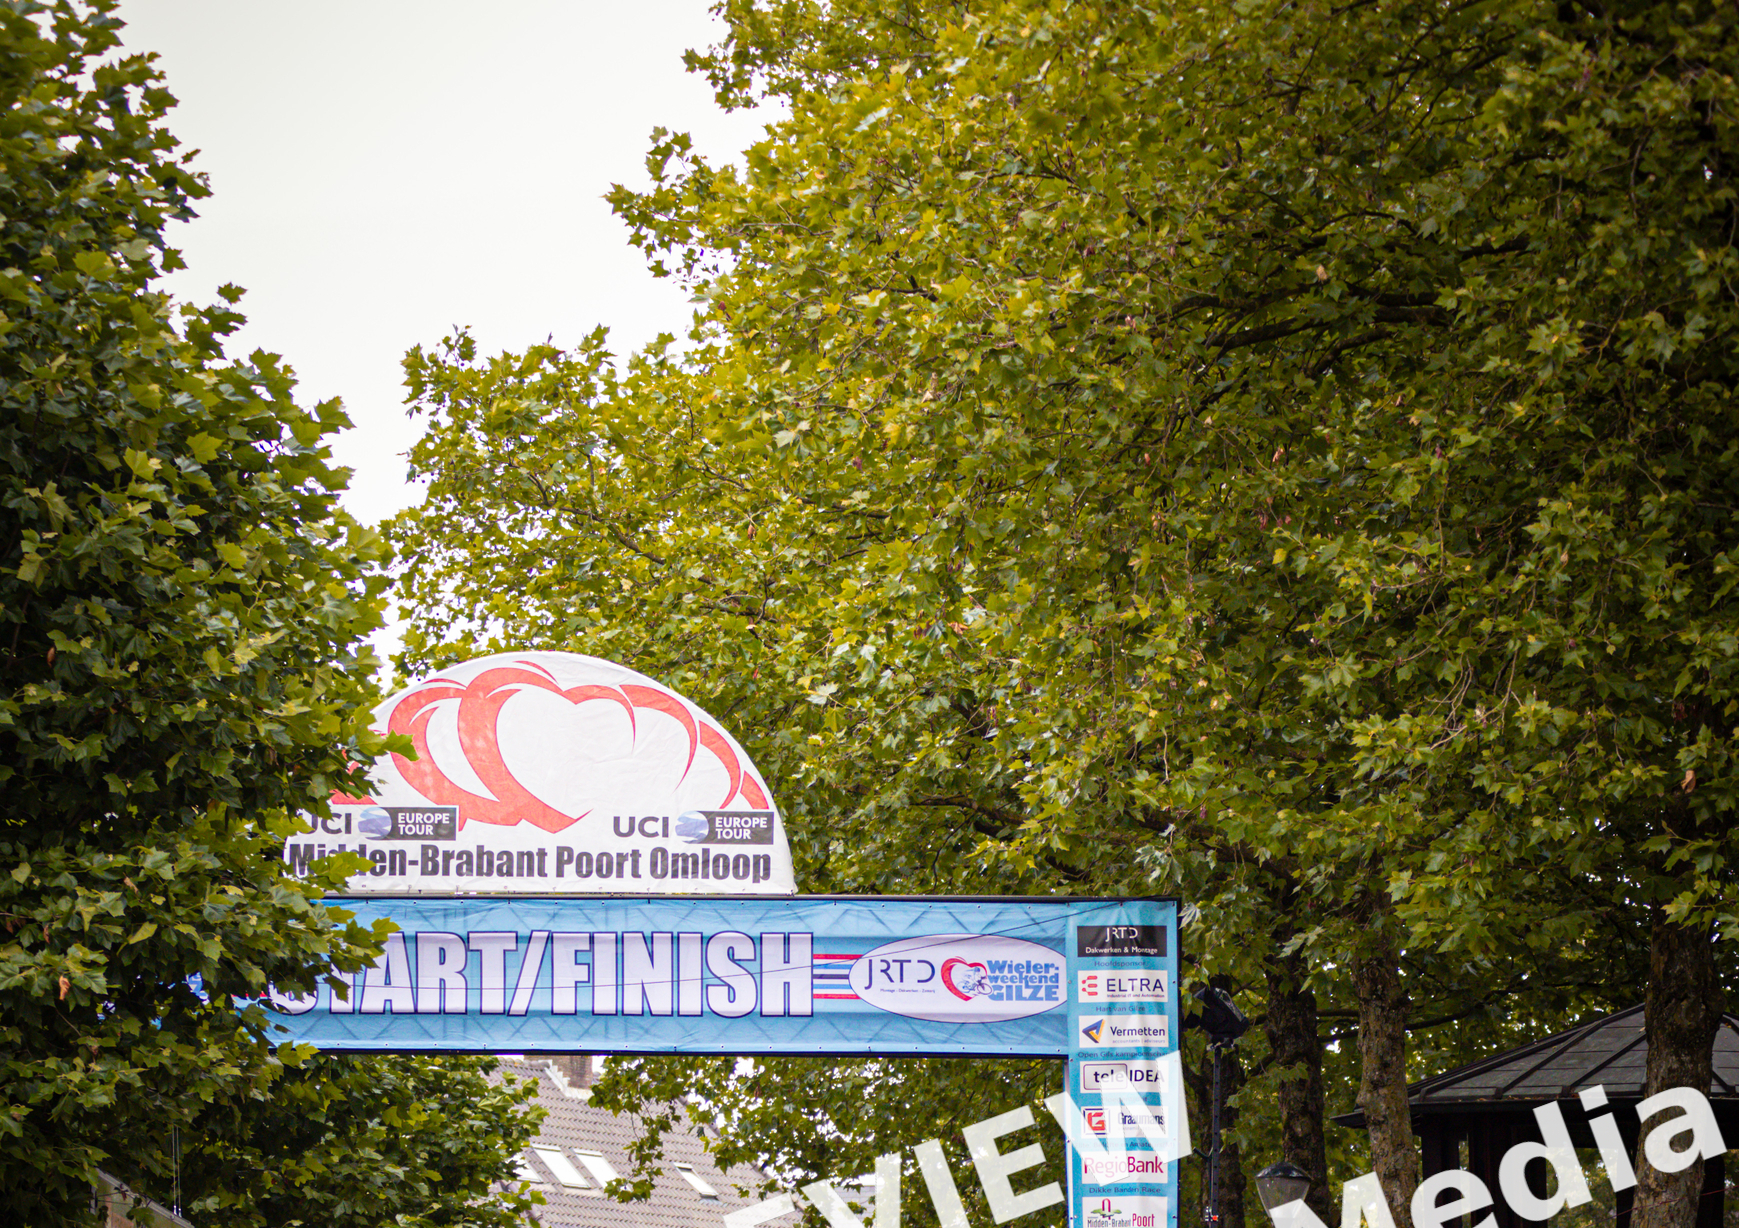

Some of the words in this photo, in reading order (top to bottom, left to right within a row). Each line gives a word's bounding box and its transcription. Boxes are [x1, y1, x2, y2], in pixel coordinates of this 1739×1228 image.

[397, 812, 450, 824] EUROPE
[715, 816, 768, 829] EUROPE
[397, 824, 435, 836] TOUR
[612, 815, 670, 839] UCI
[715, 828, 753, 840] TOUR
[555, 845, 642, 879] Poort
[649, 846, 772, 884] Omloop
[1085, 946, 1122, 955] Dakwerken
[1124, 946, 1130, 954] &
[1131, 946, 1158, 956] Montage
[1094, 960, 1146, 968] Hoofdsponsor
[987, 972, 1060, 988] weekend
[1106, 977, 1164, 993] ELTRA
[988, 984, 1060, 1002] GILZE
[1096, 1005, 1112, 1013] Hart
[1110, 1026, 1166, 1037] Vermetten
[1078, 1051, 1098, 1059] Open
[1100, 1050, 1114, 1058] Gils
[1084, 1155, 1164, 1178] RegioBank
[1142, 1186, 1162, 1194] Race
[1132, 1213, 1156, 1228] Poort
